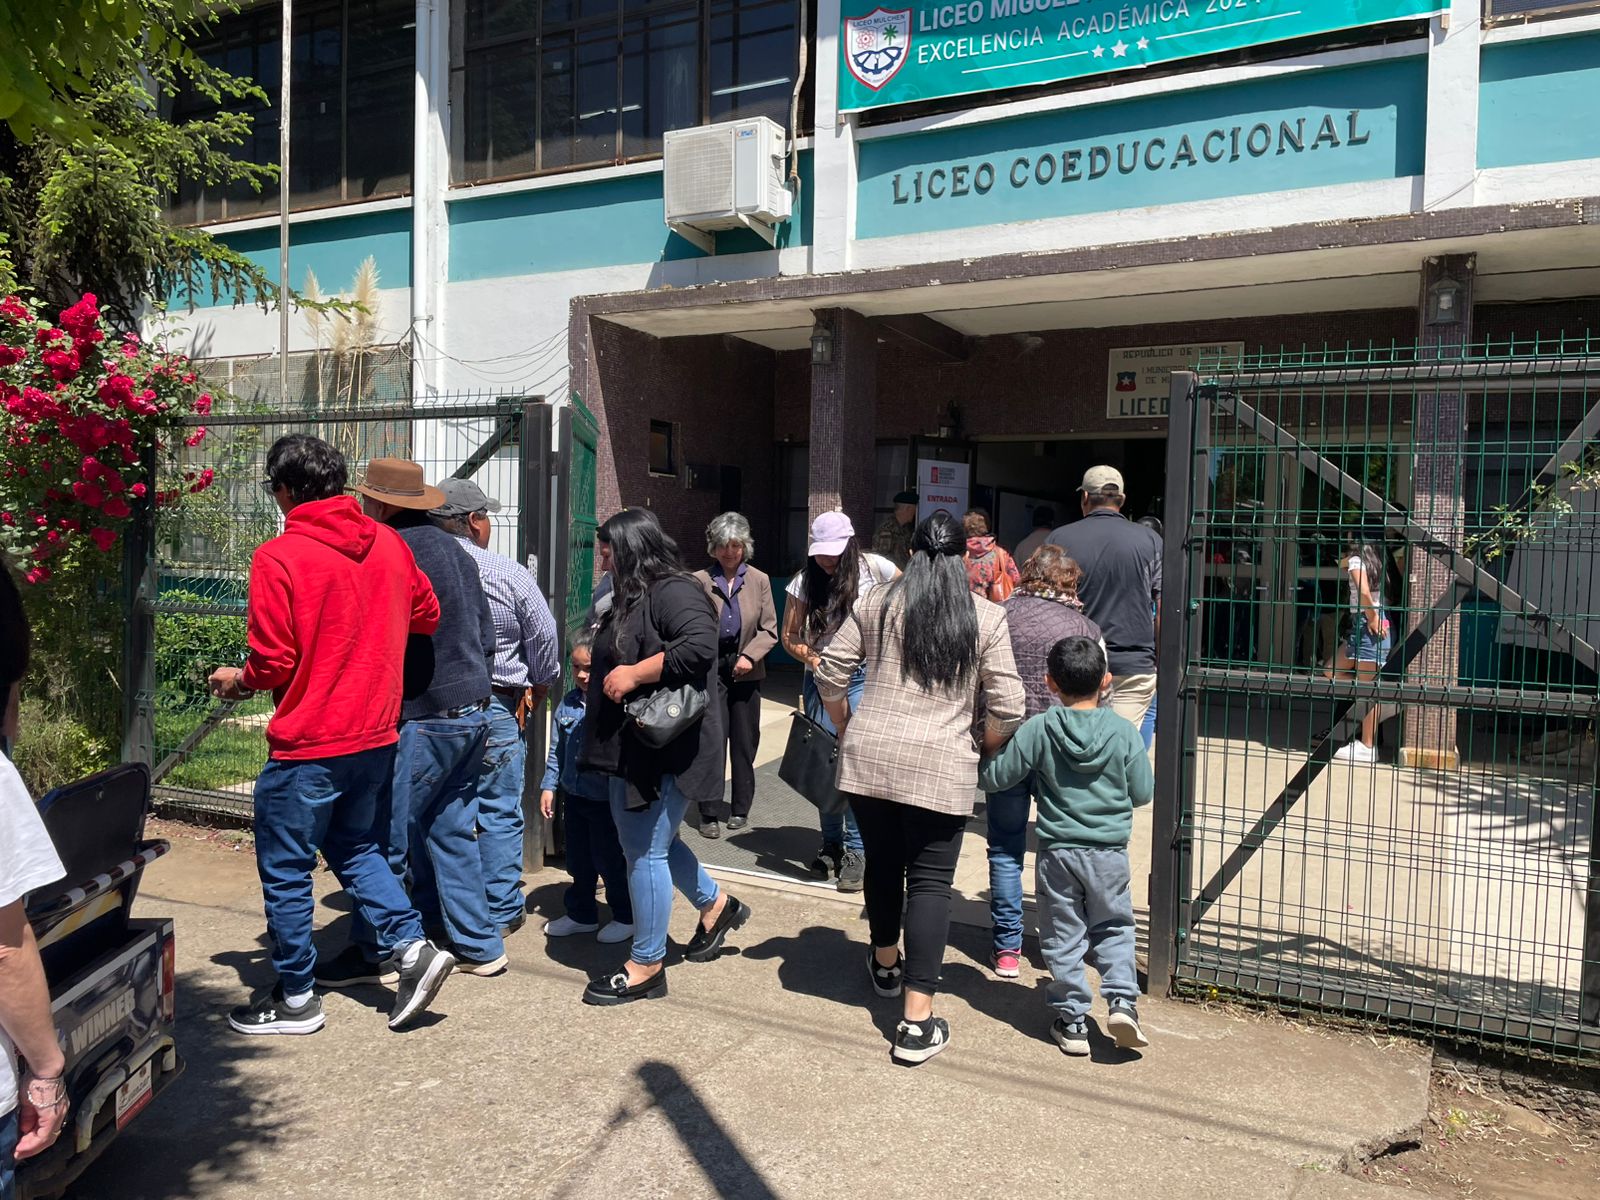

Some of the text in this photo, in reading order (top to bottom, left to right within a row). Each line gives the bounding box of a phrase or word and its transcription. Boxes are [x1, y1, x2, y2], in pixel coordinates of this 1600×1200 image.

[853, 19, 873, 28] LICEO
[918, 25, 1044, 64] EXCELENCIA
[1057, 0, 1190, 41] ACADÉMICA
[919, 1, 984, 32] LICEO
[893, 110, 1371, 204] LICEO COEDUCACIONAL
[1179, 347, 1193, 356] DE
[927, 495, 958, 503] ENTRADA
[71, 988, 136, 1055] WINNER
